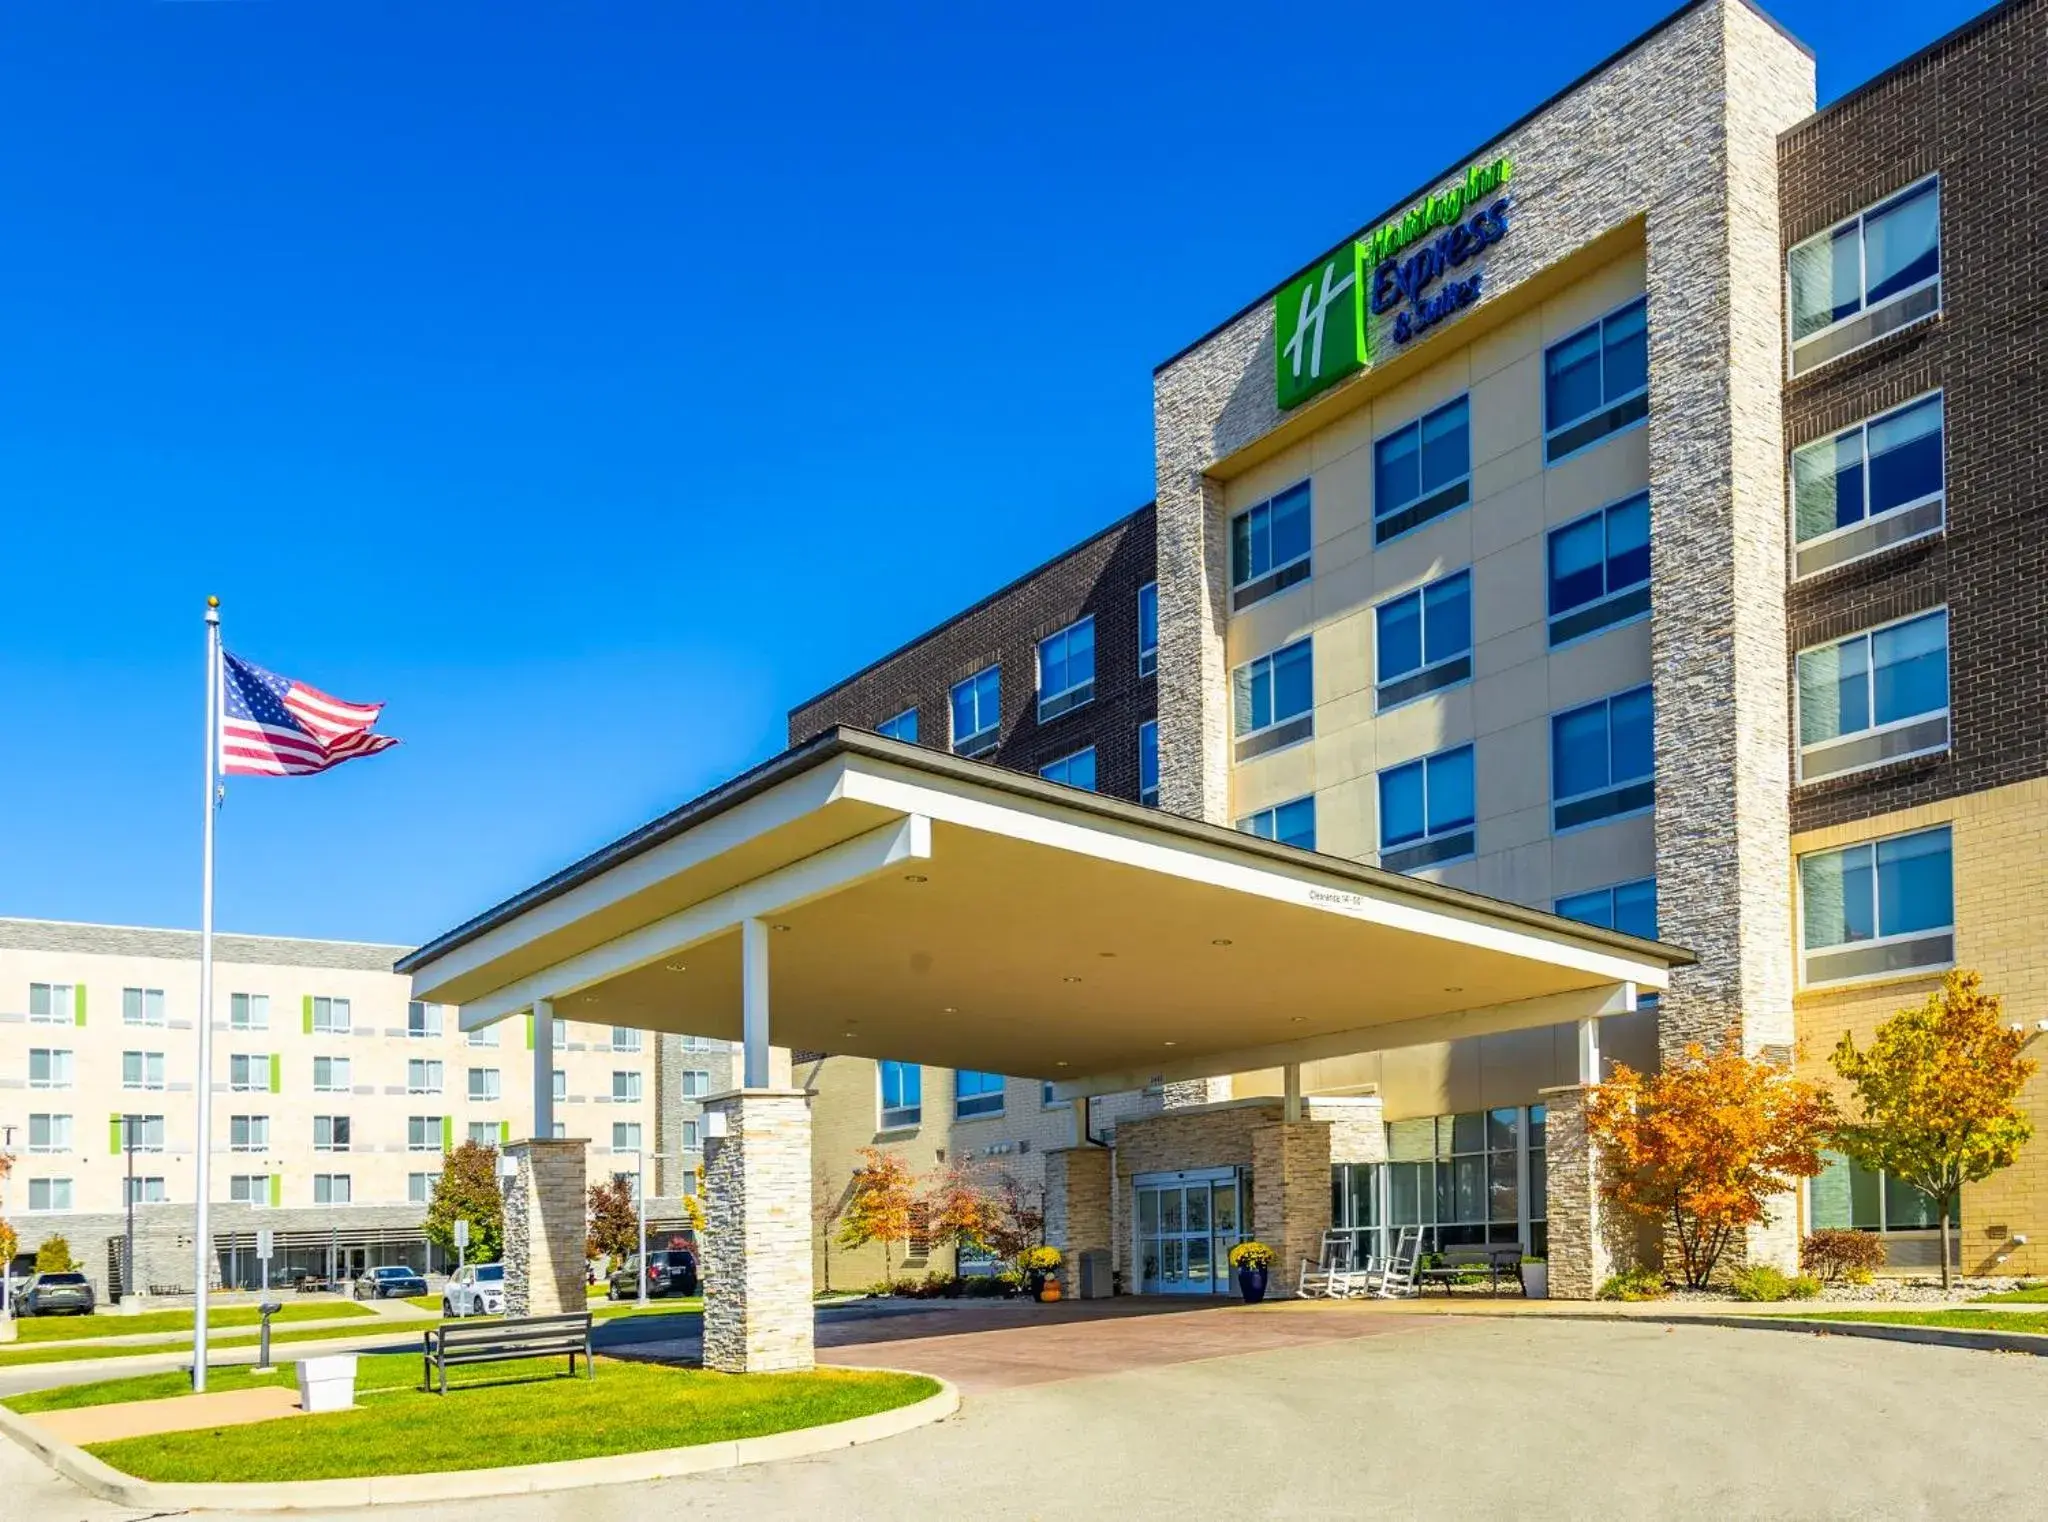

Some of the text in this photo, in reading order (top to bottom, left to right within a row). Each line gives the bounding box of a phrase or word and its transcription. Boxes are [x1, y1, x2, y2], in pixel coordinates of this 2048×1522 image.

[1368, 157, 1509, 267] Holiday Inn
[1371, 196, 1508, 315] Express
[1393, 271, 1483, 344] & Suites
